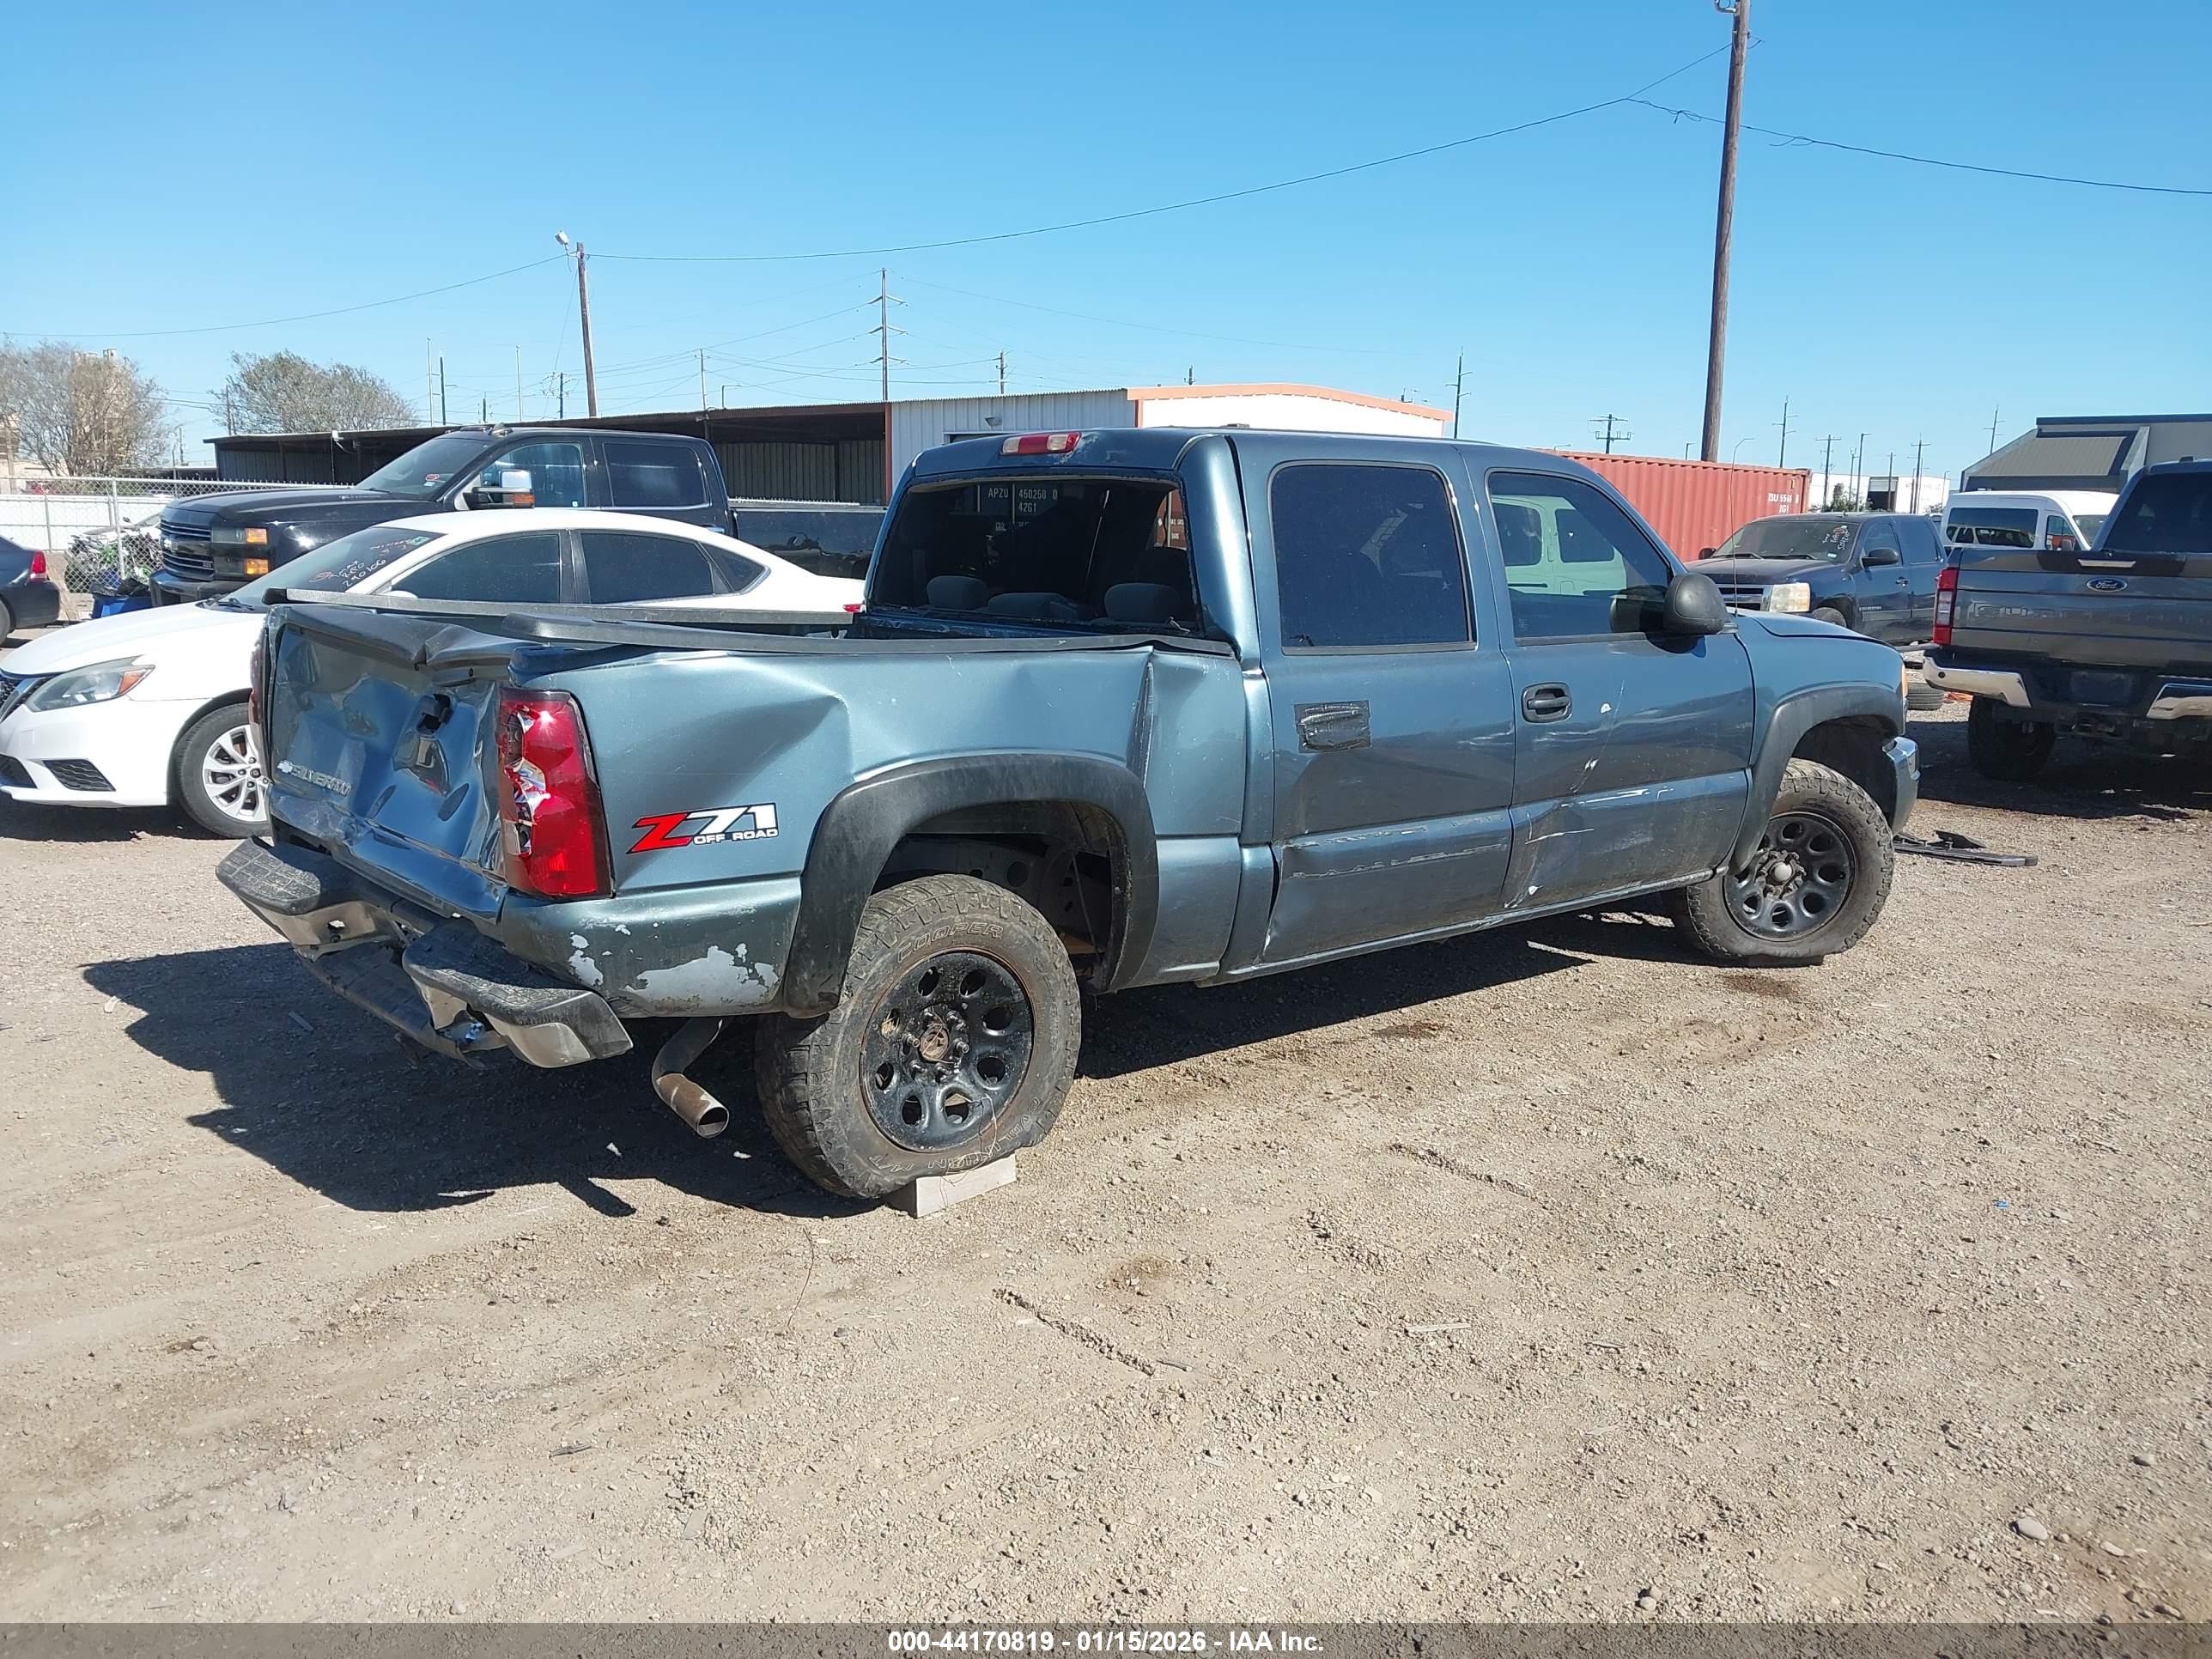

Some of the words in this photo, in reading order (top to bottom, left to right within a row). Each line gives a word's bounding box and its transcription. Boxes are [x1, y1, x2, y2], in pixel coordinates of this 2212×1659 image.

[988, 487, 1009, 498] APZU
[1018, 489, 1047, 500] 450250
[1018, 502, 1036, 513] 42G1
[626, 803, 779, 854] Z71
[693, 833, 726, 845] OFF
[732, 829, 779, 842] ROAD
[897, 921, 1004, 963] COOPER
